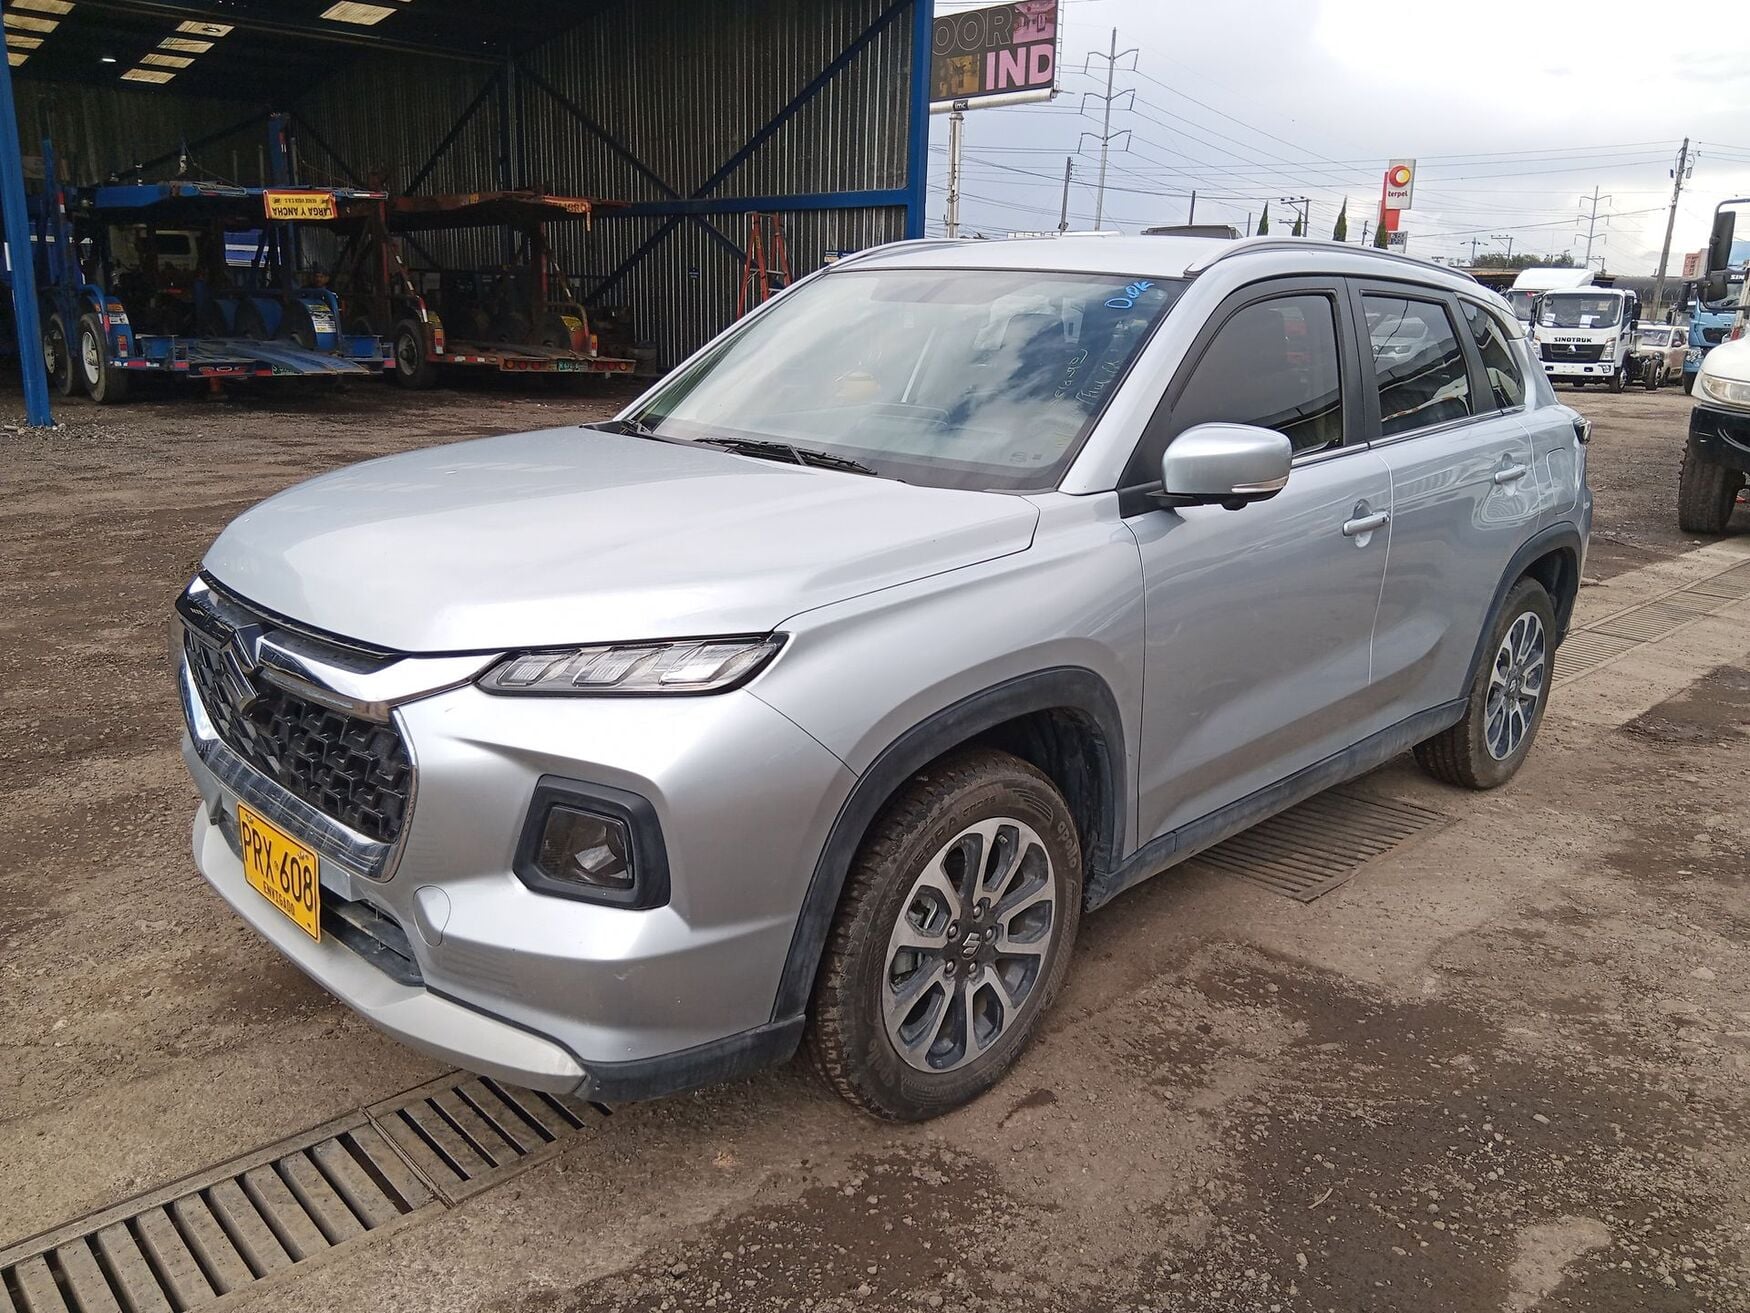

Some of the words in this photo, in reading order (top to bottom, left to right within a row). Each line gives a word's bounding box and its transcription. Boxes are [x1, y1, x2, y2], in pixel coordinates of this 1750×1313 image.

[986, 44, 1053, 90] IND
[1388, 190, 1408, 198] terpel
[271, 207, 299, 216] ANCHA
[301, 207, 307, 216] Y
[308, 207, 333, 216] LARGA
[1056, 819, 1077, 869] apollo
[241, 820, 275, 884] PRX
[279, 851, 314, 912] 608
[263, 880, 296, 917] ENVIGADO
